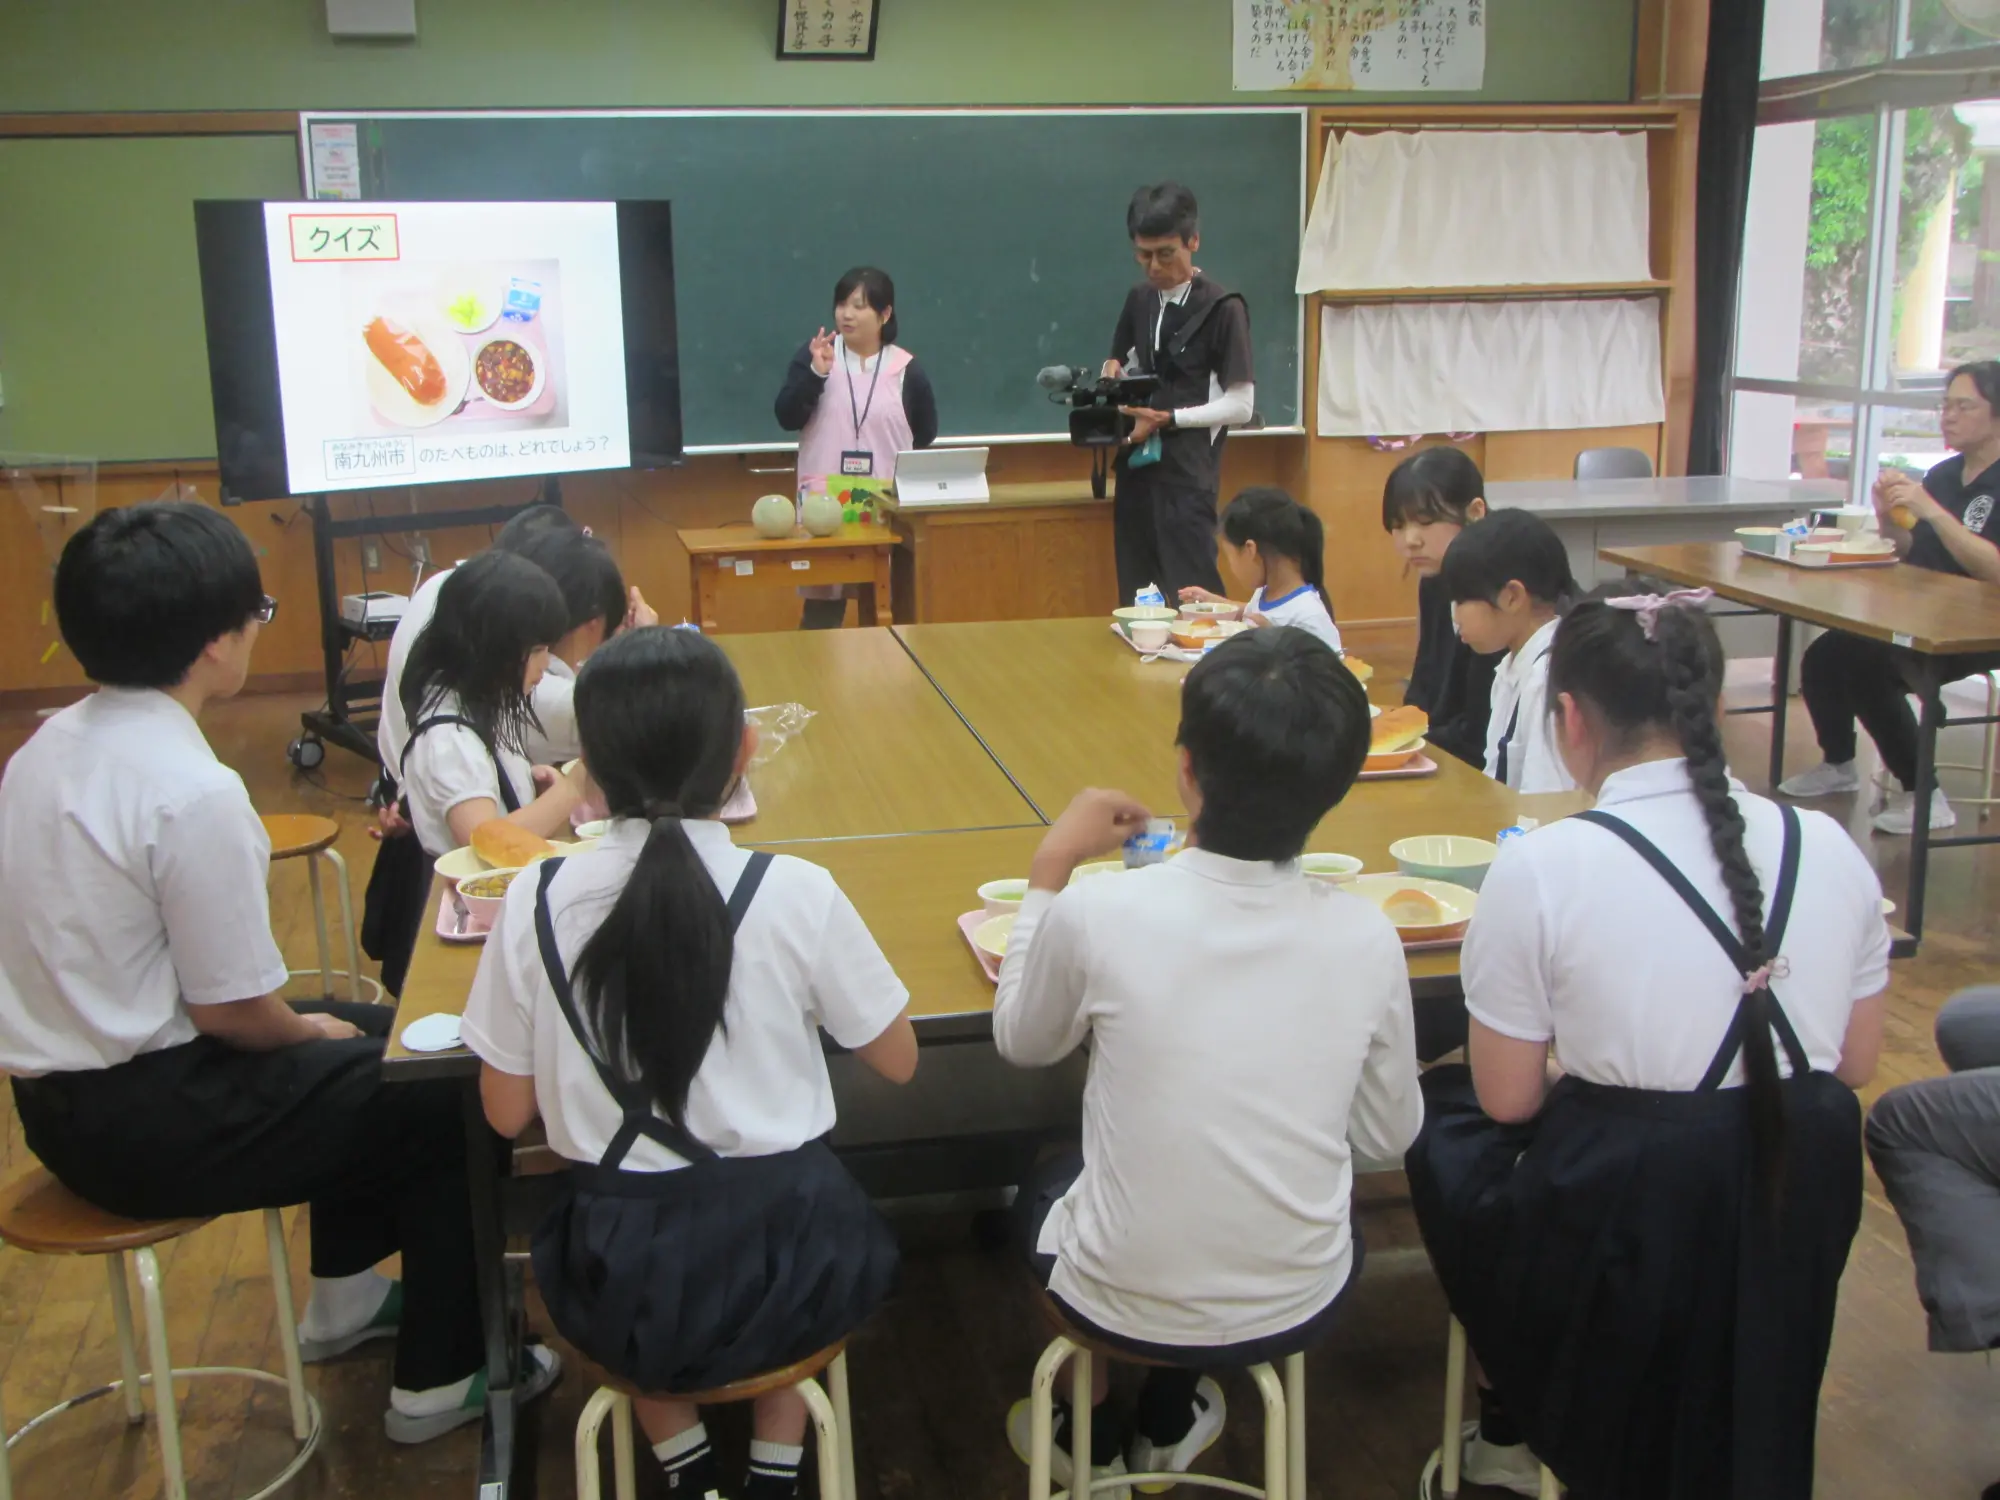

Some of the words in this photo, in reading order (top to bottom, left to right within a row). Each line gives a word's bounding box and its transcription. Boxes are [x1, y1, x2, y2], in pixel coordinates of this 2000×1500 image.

[309, 225, 382, 253] クイズ
[334, 448, 405, 470] 南九州市
